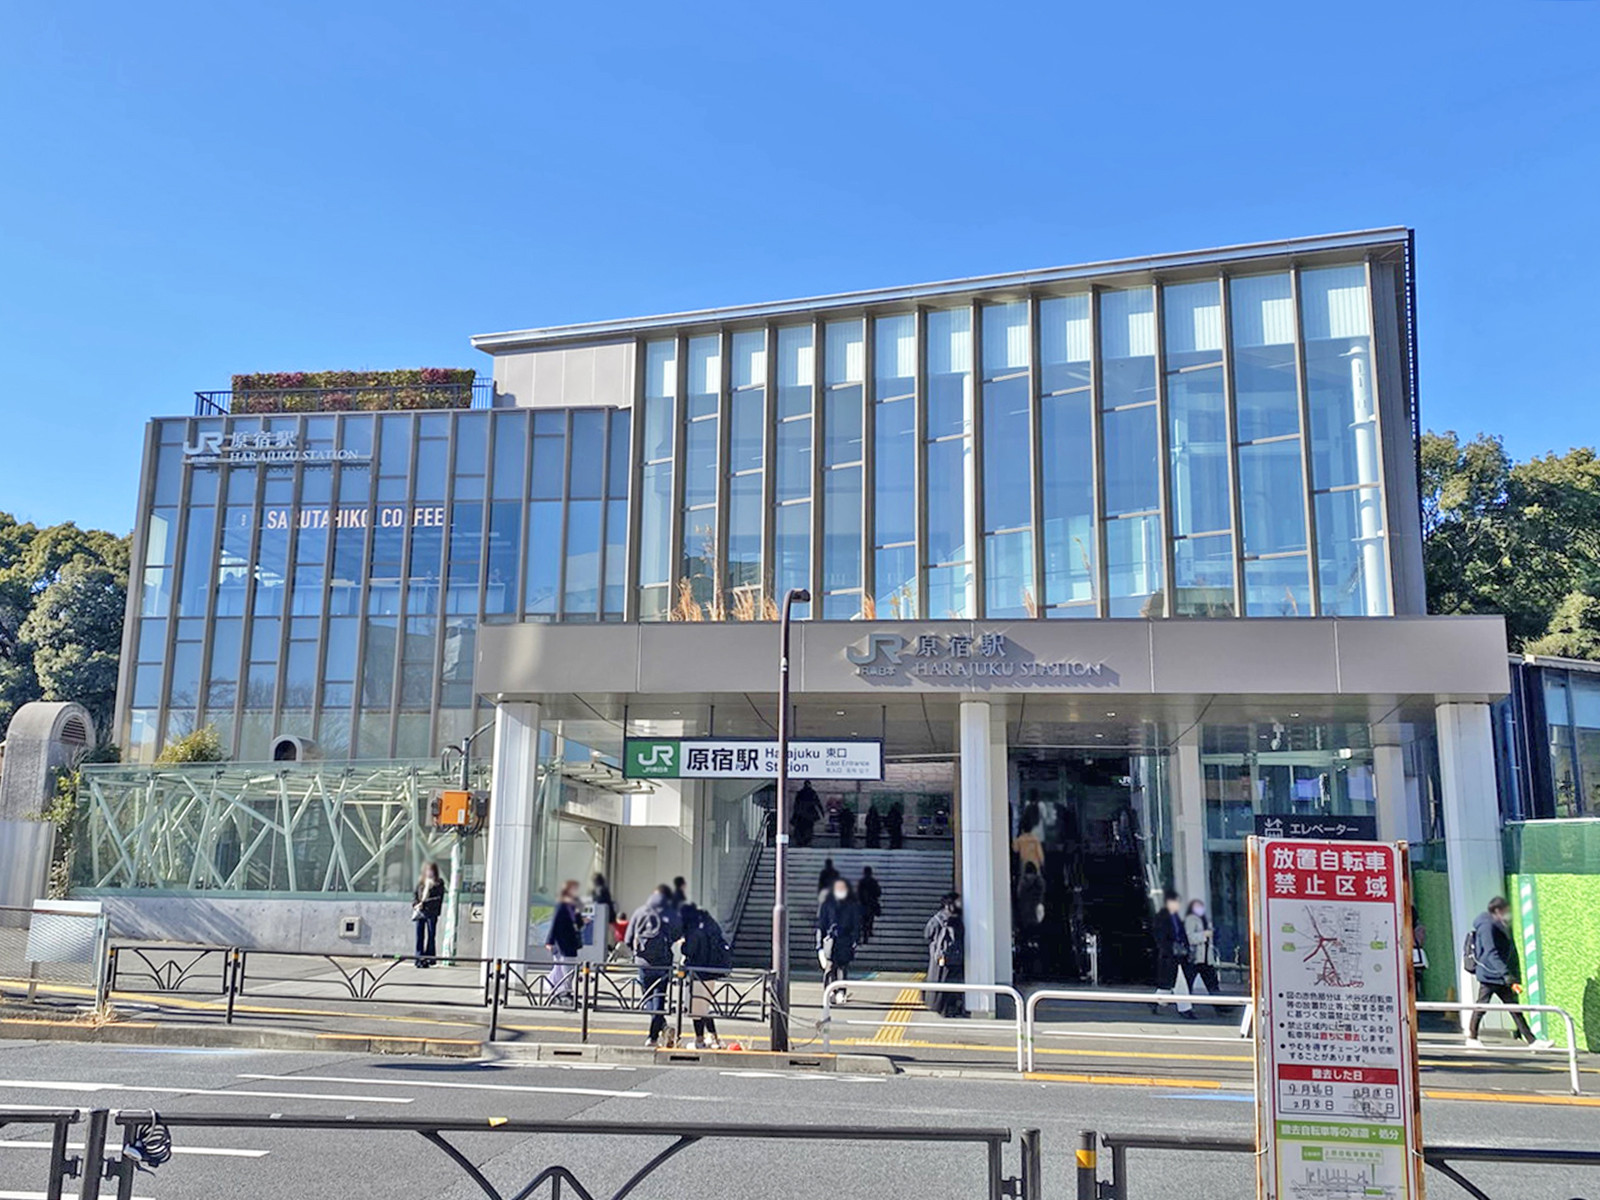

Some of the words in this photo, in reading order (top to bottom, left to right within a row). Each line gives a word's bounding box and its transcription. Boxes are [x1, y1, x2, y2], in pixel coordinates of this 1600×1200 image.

[183, 431, 224, 455] JR
[231, 430, 297, 448] 原宿駅
[229, 449, 299, 463] HARAJUKU
[302, 449, 359, 461] STATION
[267, 508, 369, 529] SAUTAHIKO
[381, 507, 445, 527] COFEE
[844, 633, 902, 664] JR
[916, 634, 1006, 658] 原宿駅
[914, 661, 1013, 678] HARAJUKU
[1019, 661, 1102, 677] STATION
[638, 745, 674, 766] JR
[686, 748, 759, 771] 原宿駅
[765, 748, 820, 760] Haajuku
[826, 748, 847, 758] 東口
[765, 761, 809, 772] Stion
[1290, 823, 1359, 835] エレベーター
[1273, 847, 1387, 872] 放置自転車
[1274, 872, 1388, 898] 禁止区域
